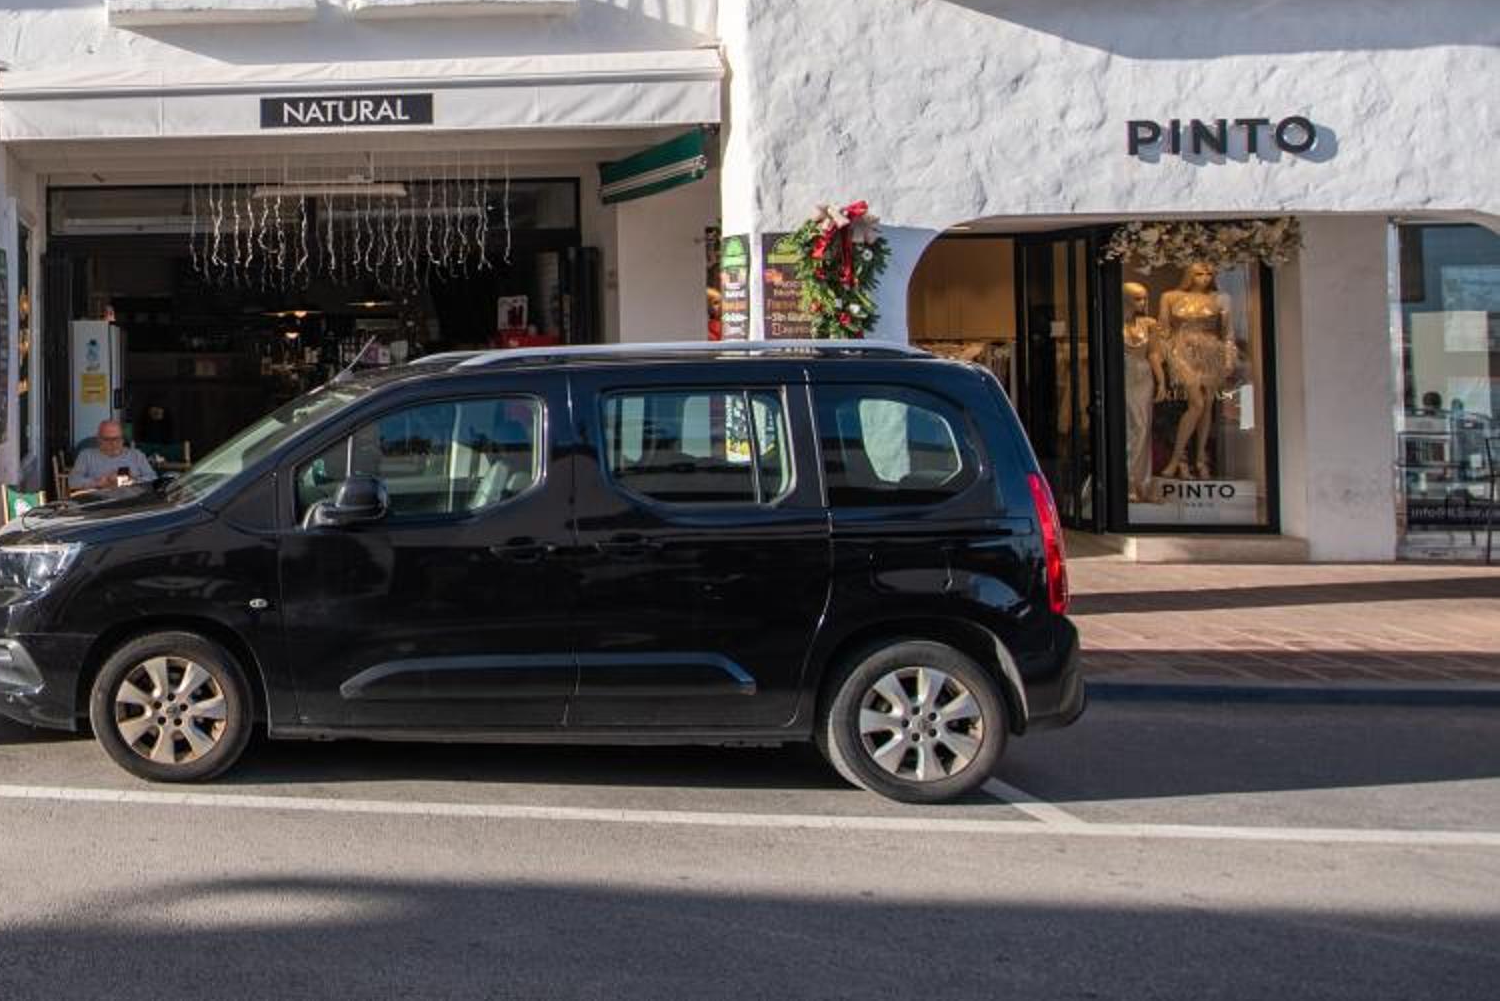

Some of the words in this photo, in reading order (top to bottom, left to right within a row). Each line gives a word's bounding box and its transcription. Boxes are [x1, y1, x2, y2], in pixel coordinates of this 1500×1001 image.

[283, 98, 410, 124] NATURAL
[1125, 116, 1316, 155] PINTO
[1162, 483, 1235, 499] PINTO
